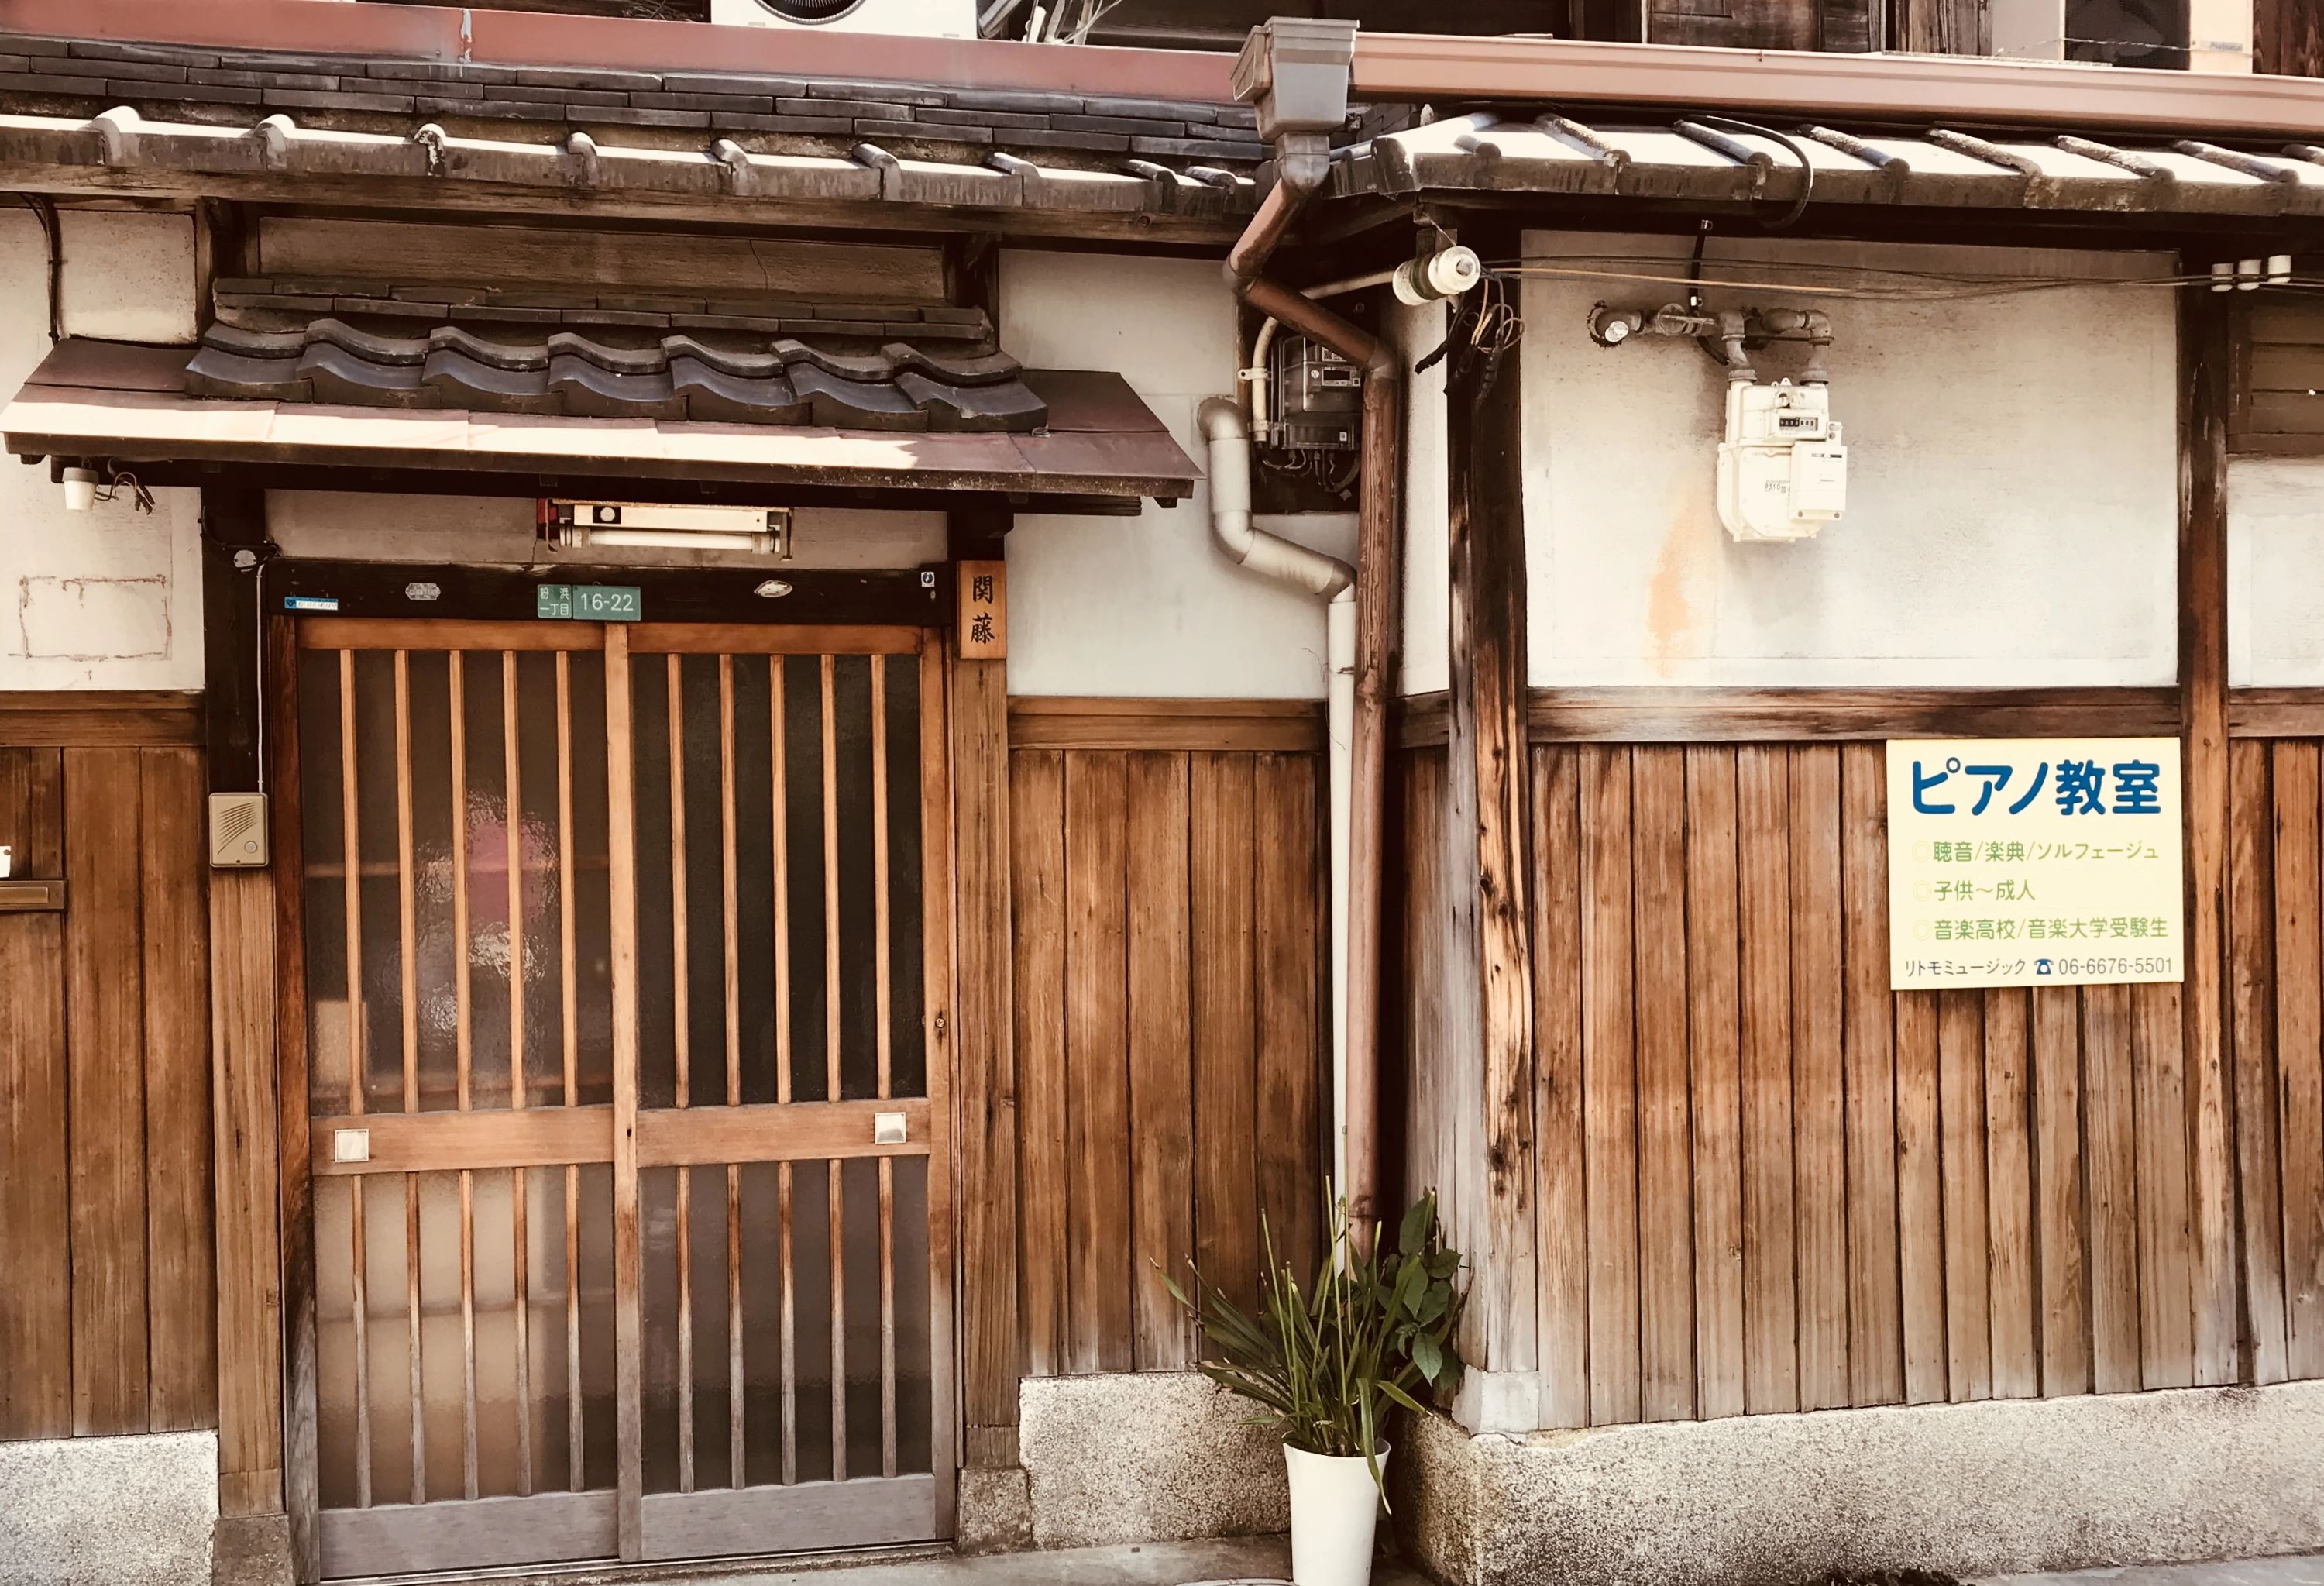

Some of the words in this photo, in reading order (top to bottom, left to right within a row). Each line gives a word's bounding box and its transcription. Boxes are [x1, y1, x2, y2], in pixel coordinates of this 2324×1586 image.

[539, 603, 569, 616] 一丁目
[580, 593, 634, 611] 16-22
[971, 575, 995, 644] 関藤
[1912, 756, 2161, 816] ピアノ教室
[1906, 958, 2026, 977] リトモミュージック
[2058, 957, 2171, 975] 06-6676-5501
